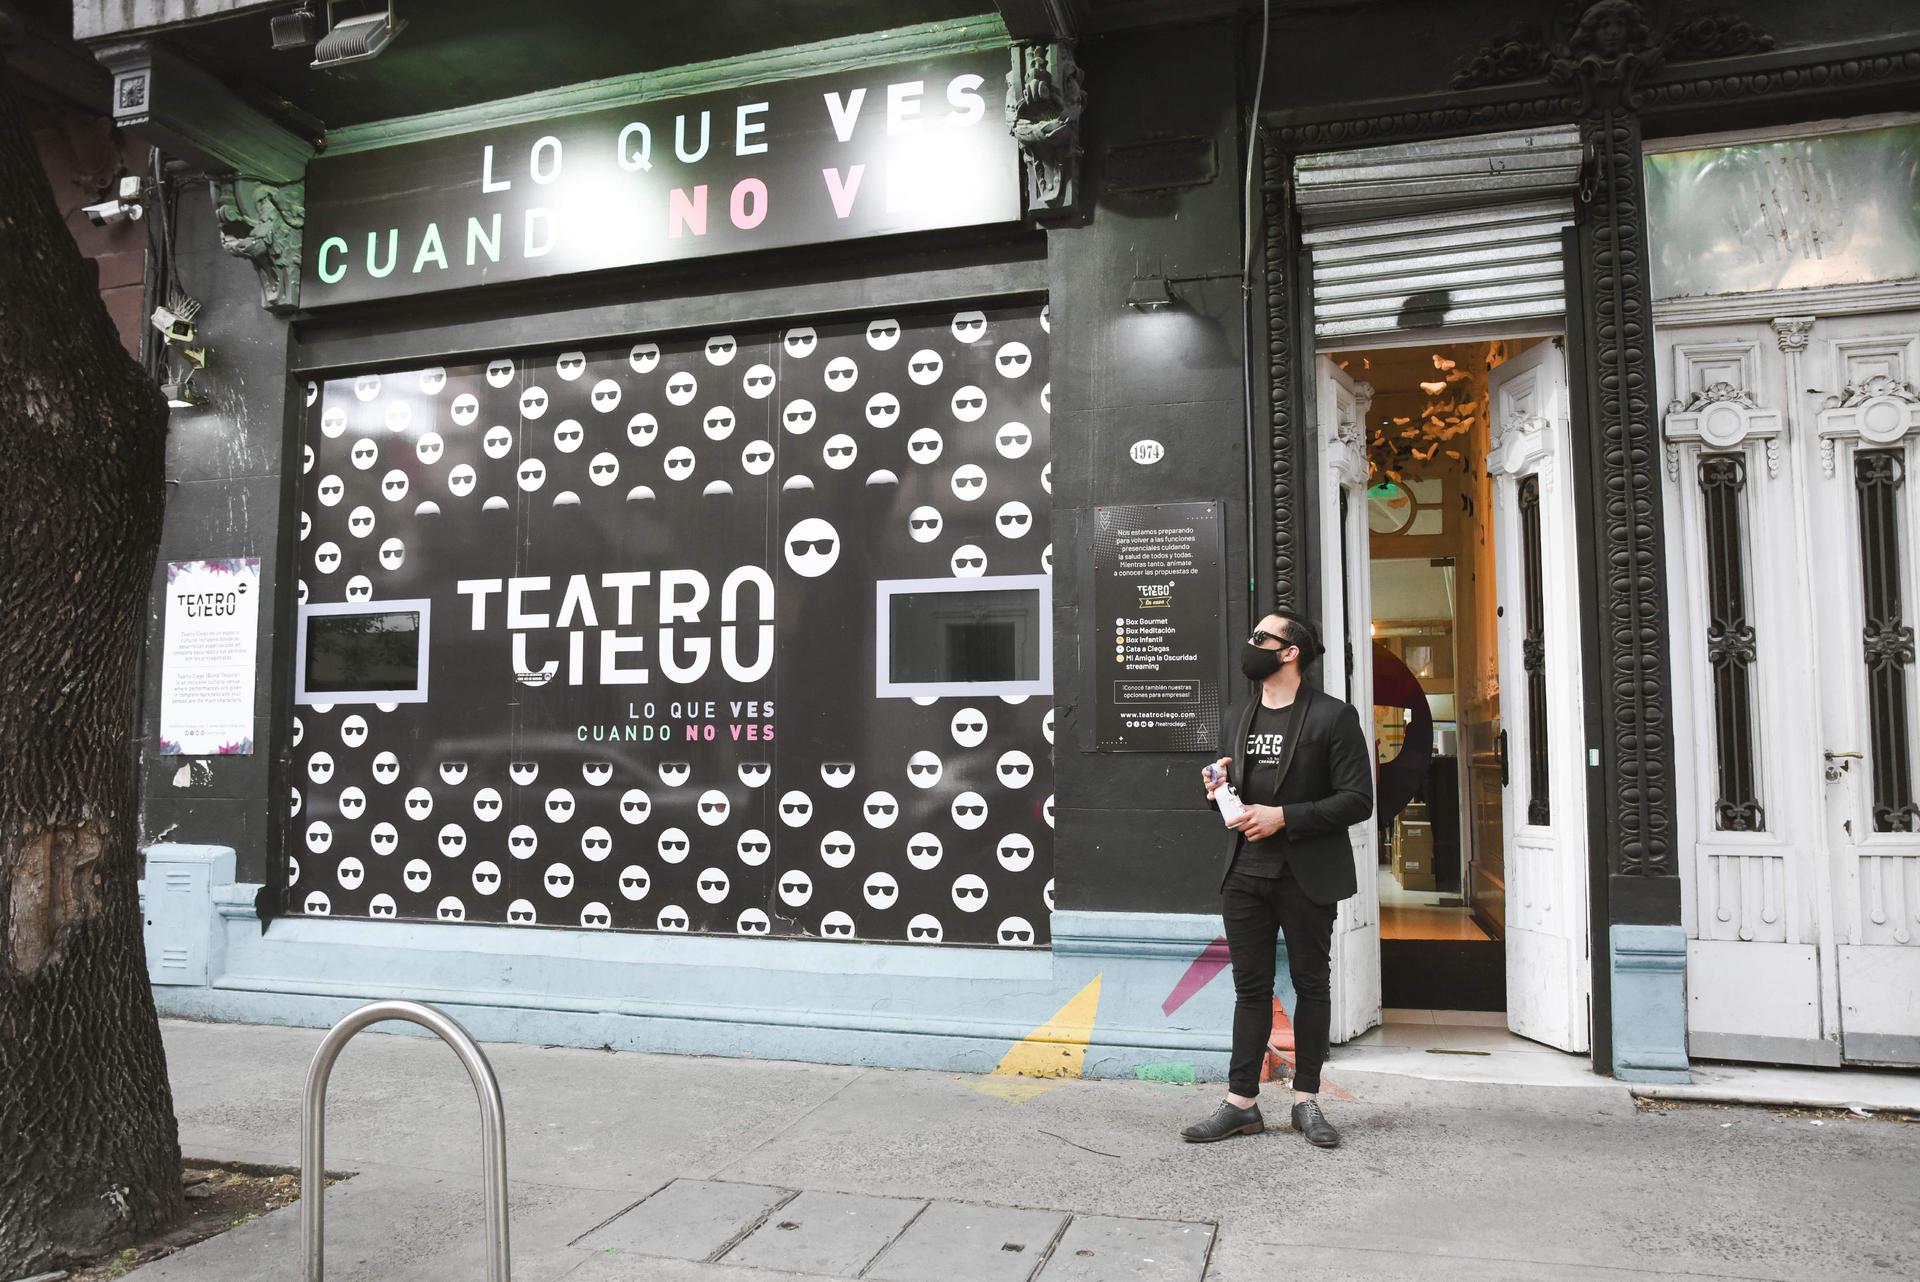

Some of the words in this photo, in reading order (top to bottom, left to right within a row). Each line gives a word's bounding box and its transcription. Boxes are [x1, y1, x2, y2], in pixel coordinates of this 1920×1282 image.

[481, 135, 563, 194] LO
[617, 102, 770, 172] QUE
[823, 74, 985, 143] VES
[318, 207, 557, 284] CUAND
[669, 177, 768, 239] NO
[1134, 444, 1160, 460] 1974
[178, 592, 236, 606] TEATRO
[457, 565, 775, 630] TEATRO
[188, 604, 236, 617] CIEGO
[512, 625, 775, 686] CIEGO
[629, 702, 656, 719] LO
[671, 701, 716, 720] QUE
[730, 700, 775, 718] VES
[577, 725, 671, 742] CUANDO
[686, 724, 715, 741] NO
[730, 724, 775, 741] VES
